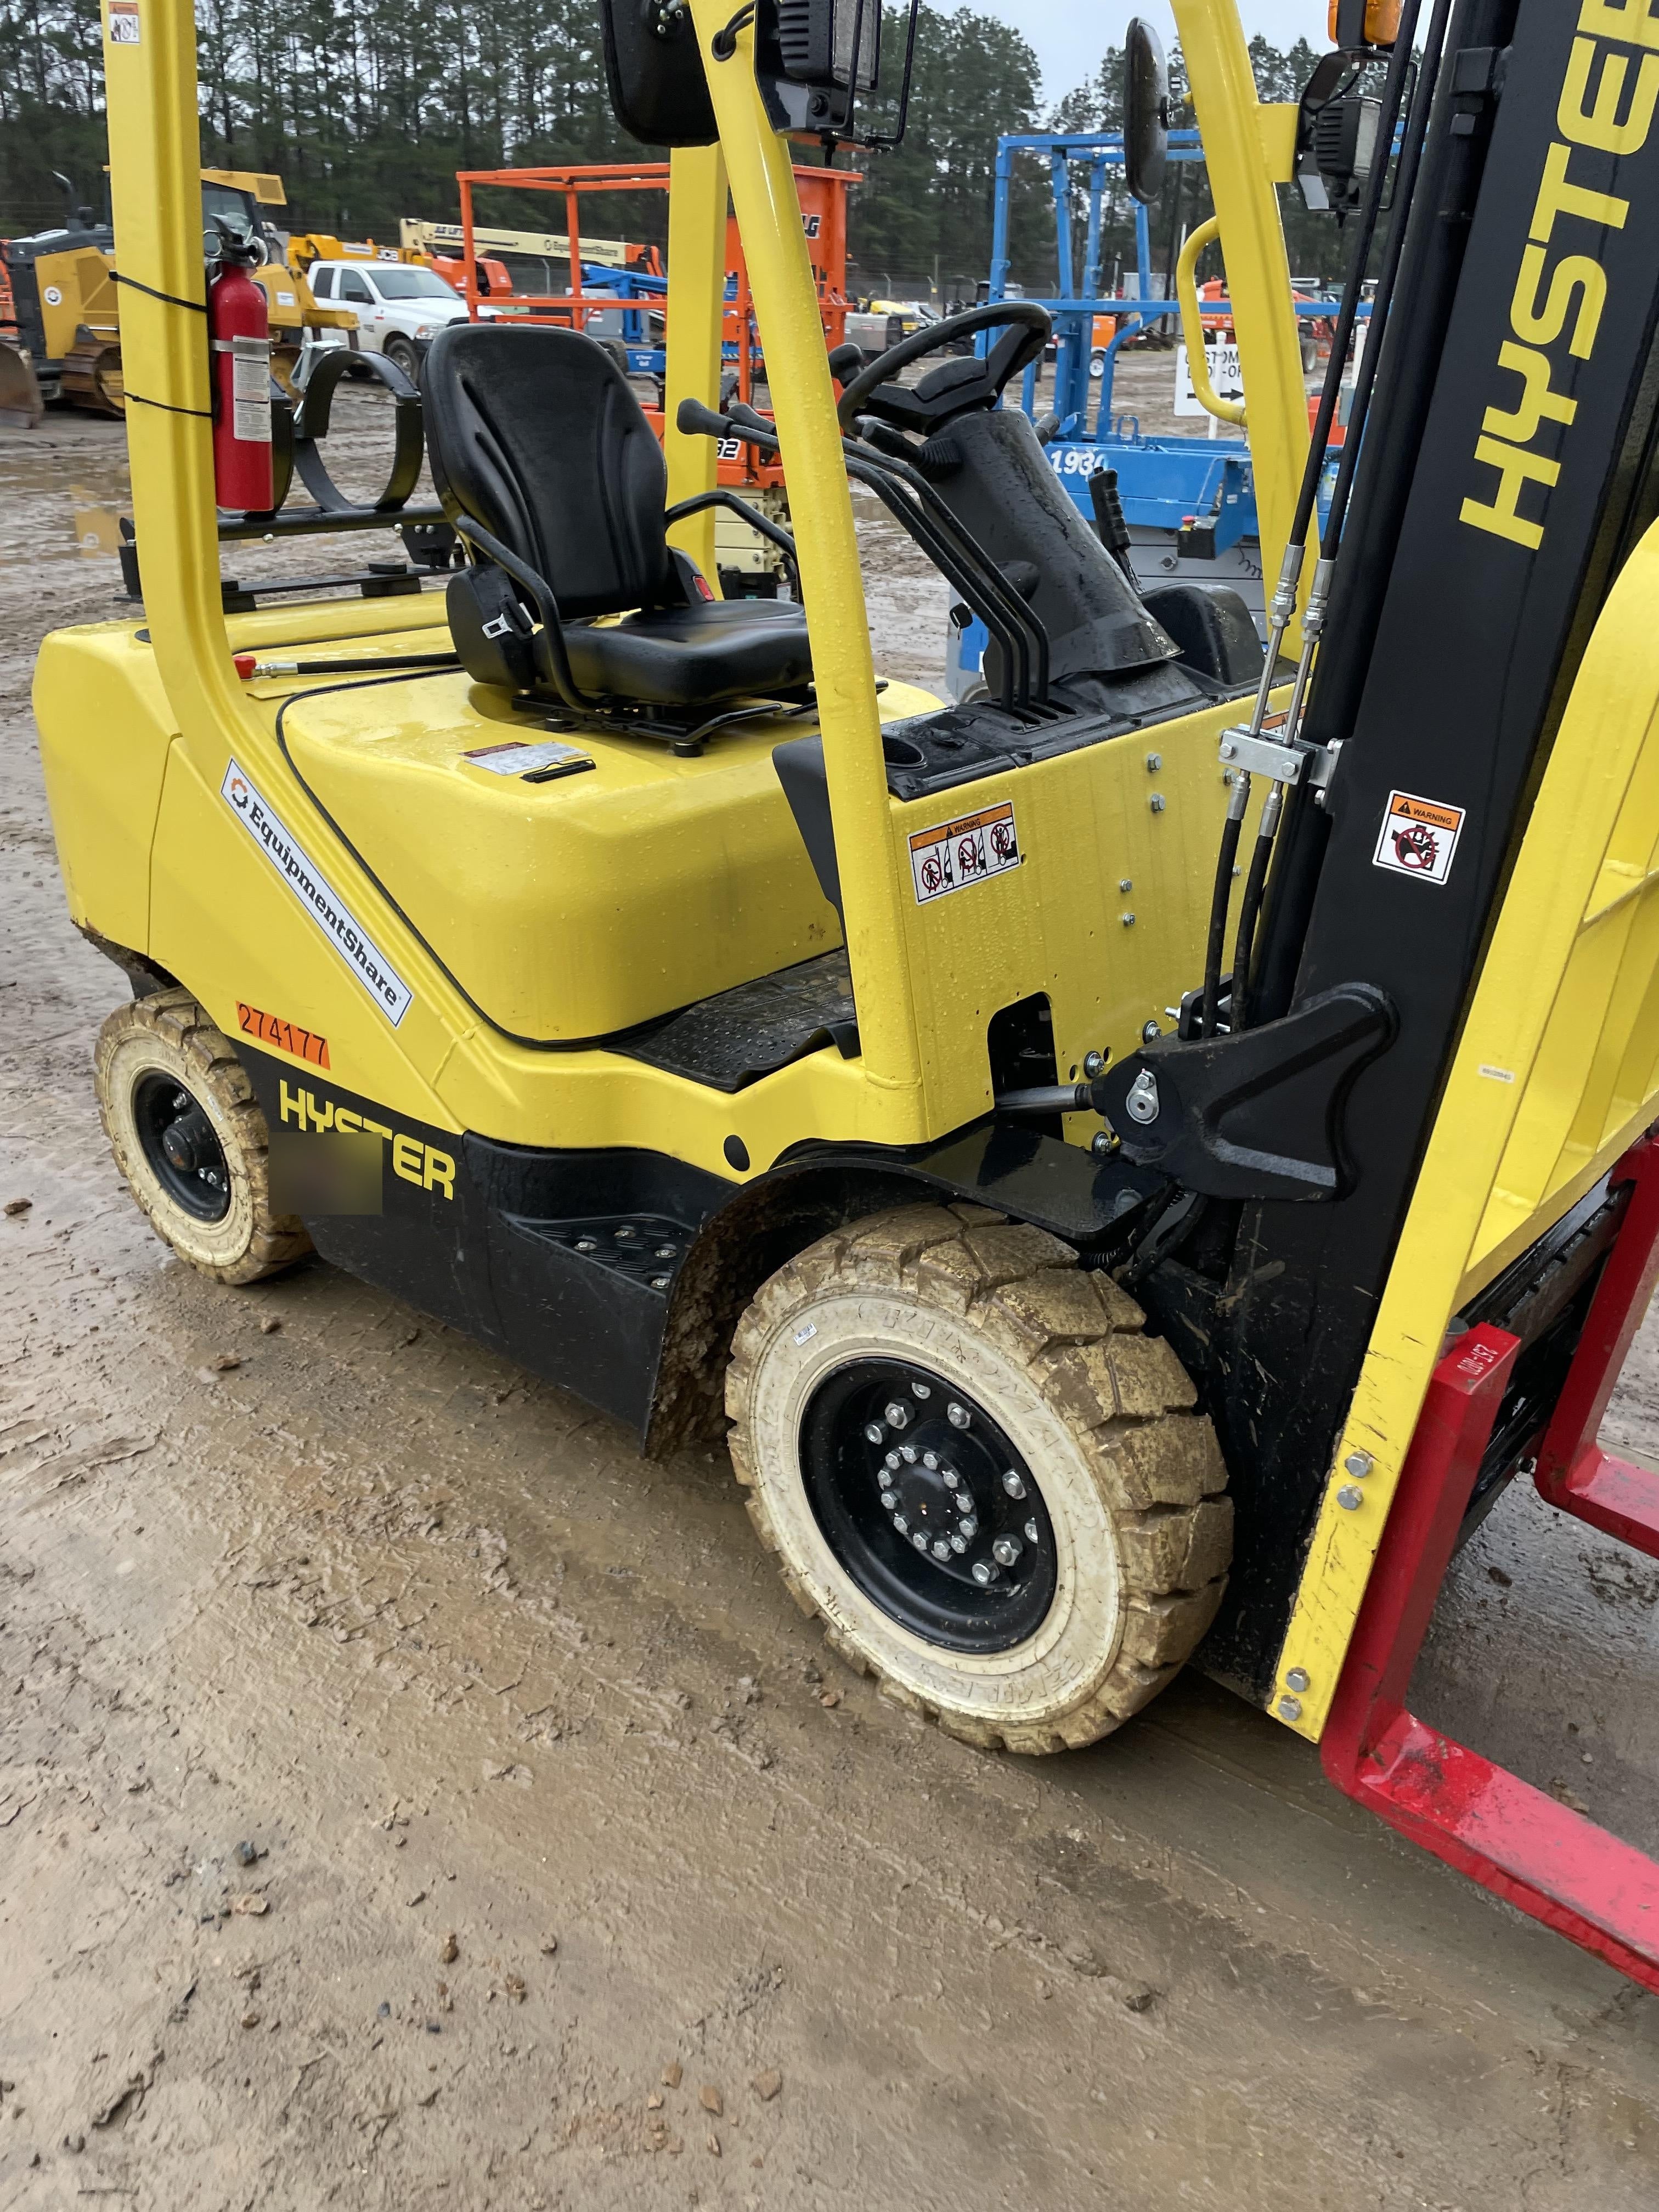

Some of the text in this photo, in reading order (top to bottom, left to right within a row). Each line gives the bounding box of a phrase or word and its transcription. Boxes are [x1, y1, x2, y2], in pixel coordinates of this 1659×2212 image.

[954, 818, 981, 833] WARNING
[1413, 808, 1452, 825] WARNING
[249, 801, 397, 1006] EquipmentShare
[239, 1003, 326, 1065] 274177
